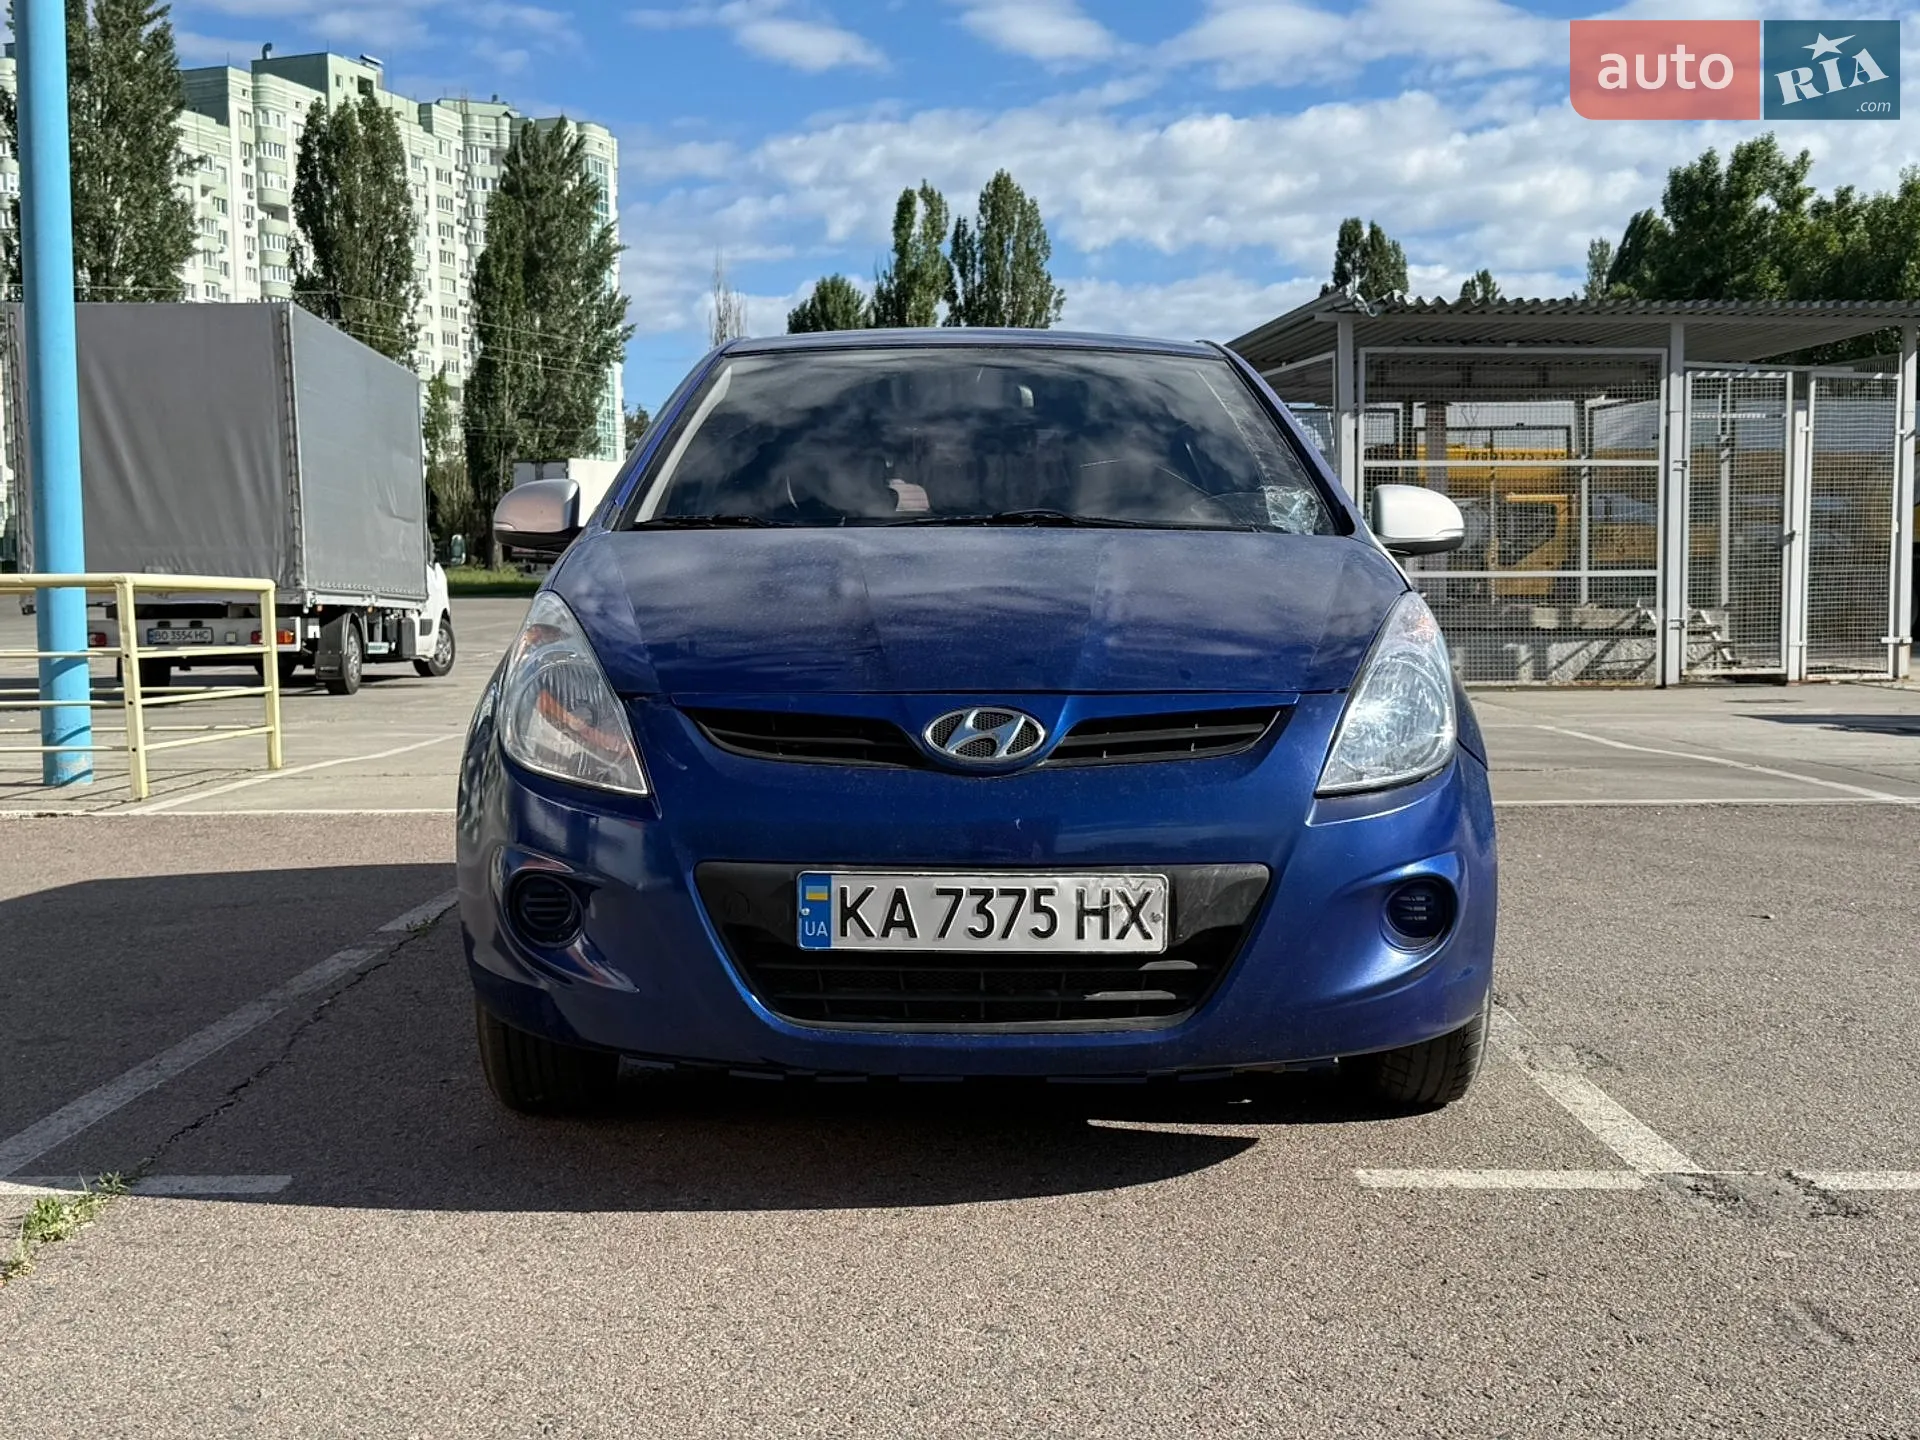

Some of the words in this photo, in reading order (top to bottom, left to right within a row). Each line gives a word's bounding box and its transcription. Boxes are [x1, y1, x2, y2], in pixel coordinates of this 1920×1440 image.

[805, 920, 828, 937] UA
[839, 886, 918, 939] KA
[935, 887, 1058, 940] 7375
[1076, 888, 1154, 940] HX
